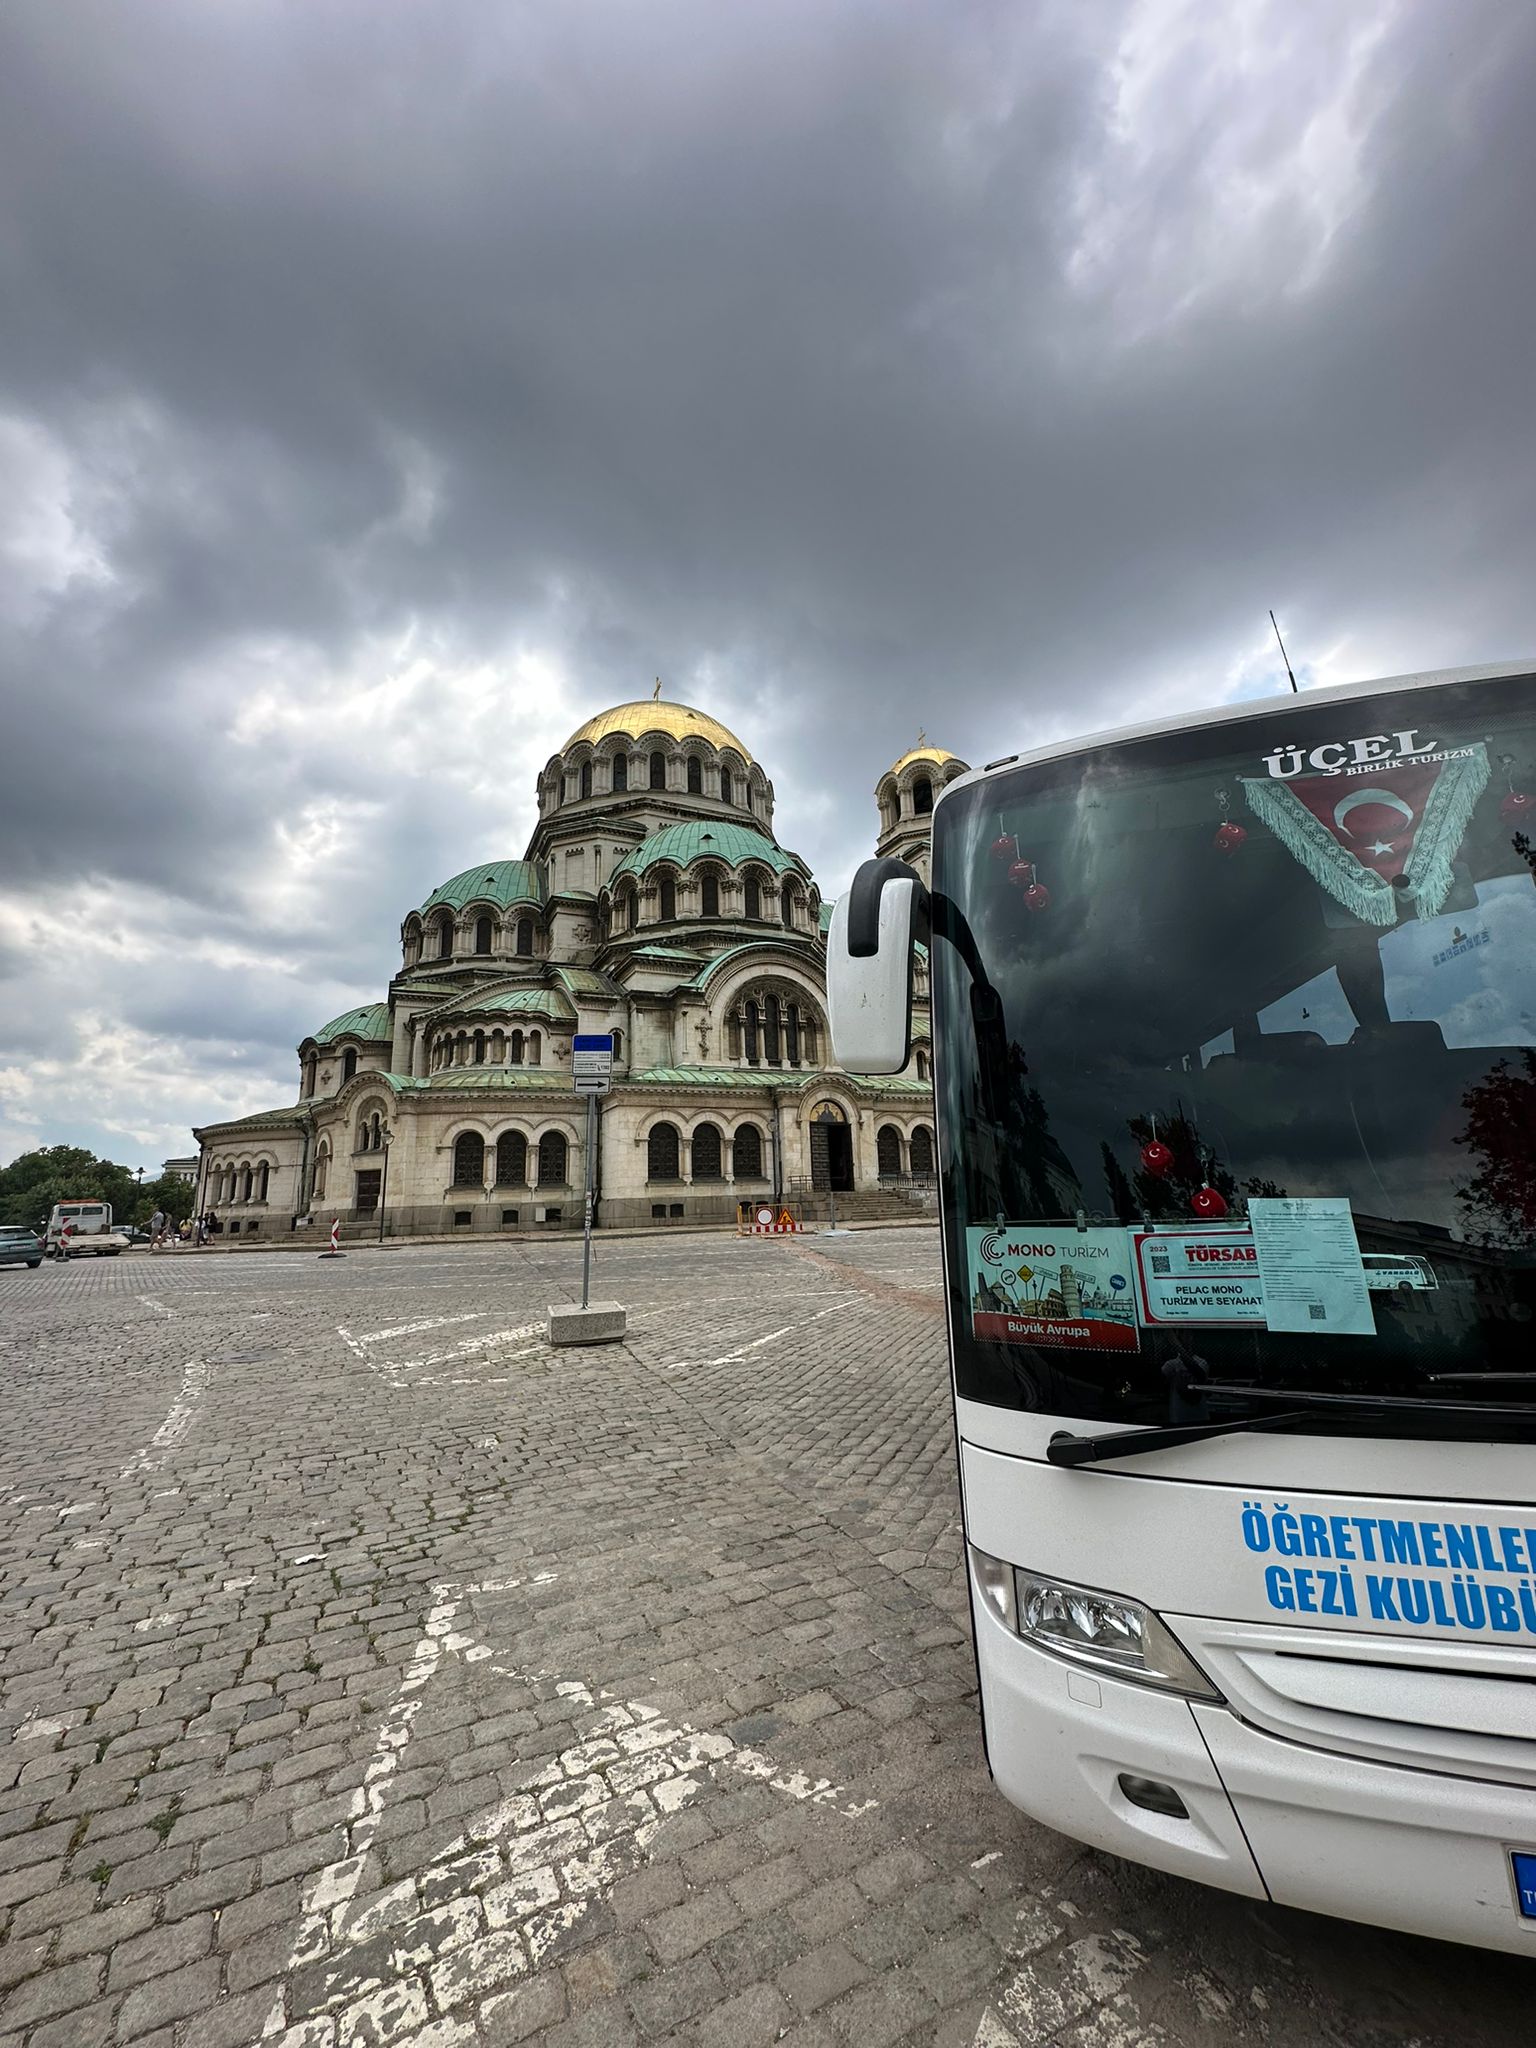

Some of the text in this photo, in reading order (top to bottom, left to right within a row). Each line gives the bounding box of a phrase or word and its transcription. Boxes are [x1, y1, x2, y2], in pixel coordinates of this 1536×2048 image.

[1261, 729, 1438, 779] ÜÇEL
[1346, 747, 1475, 777] BİRLİK TURİZM
[1007, 1243, 1110, 1259] MONO TURİZM
[1185, 1244, 1257, 1262] TÜRSAB
[1175, 1285, 1243, 1295] PELAC MONO
[1160, 1296, 1263, 1306] TURİZM VE SEYAHAT
[1007, 1321, 1091, 1338] Büyük Avrupa
[1264, 1564, 1358, 1617] GEZİ
[1523, 1889, 1536, 1905] T
